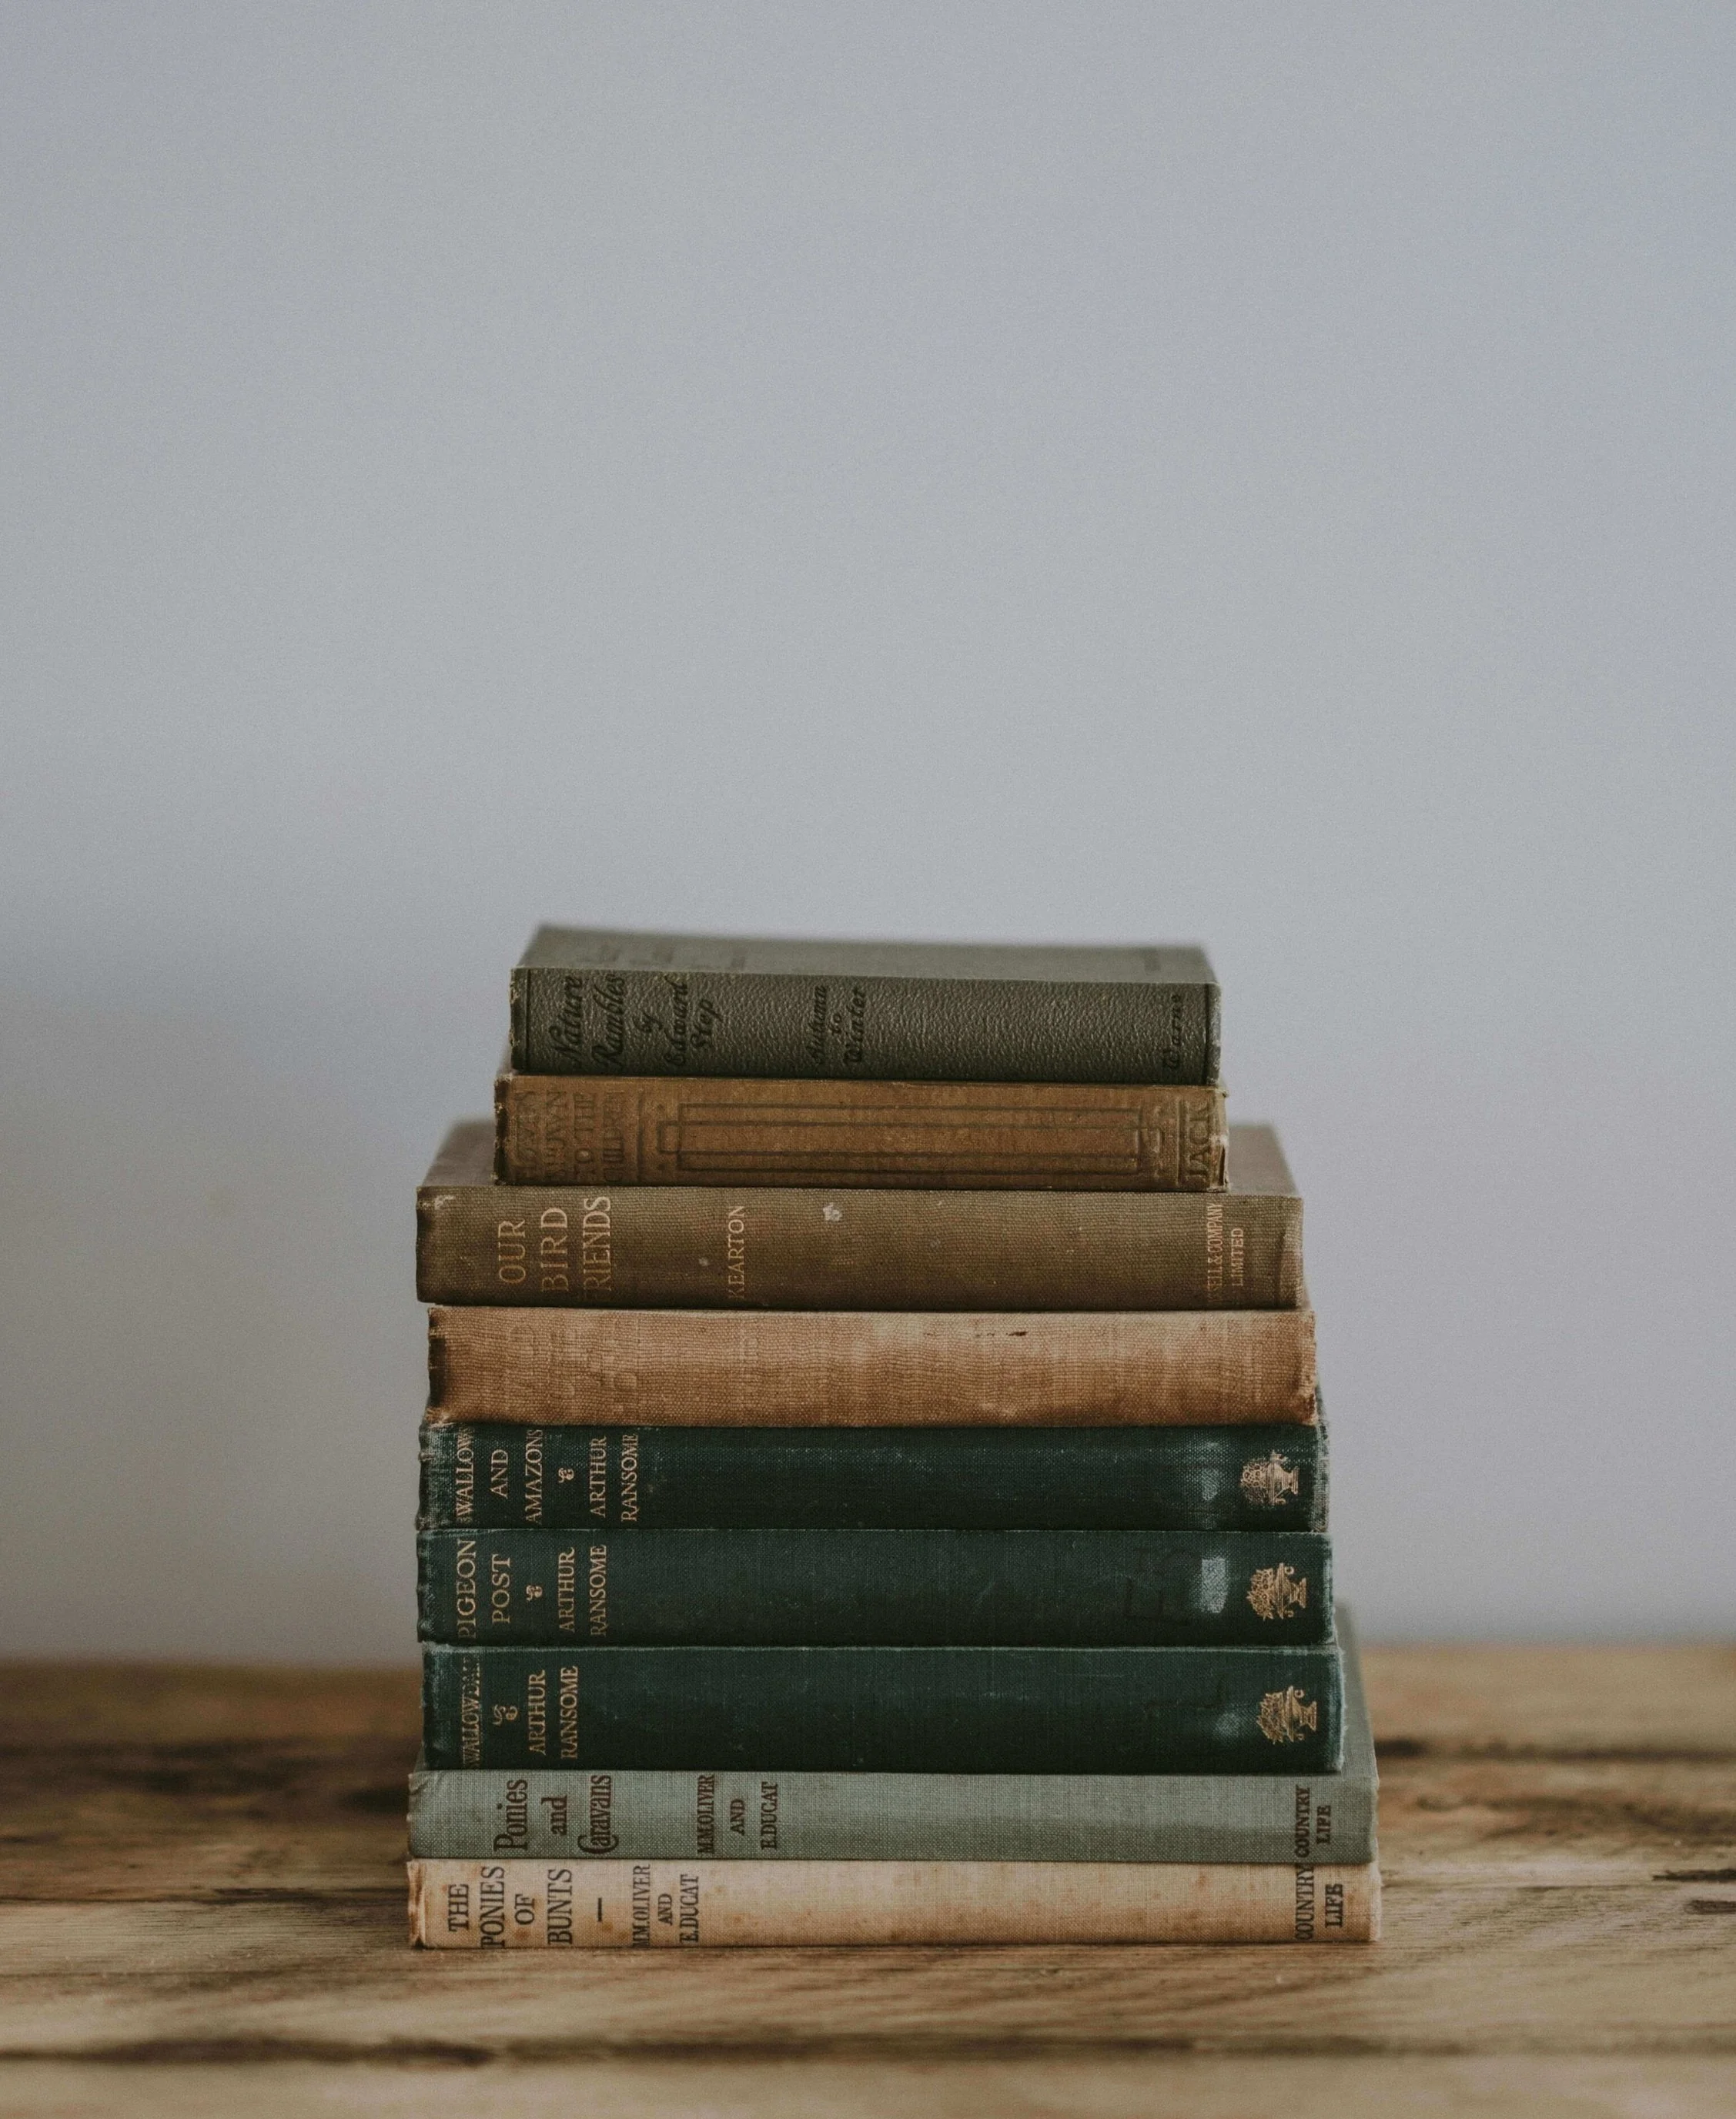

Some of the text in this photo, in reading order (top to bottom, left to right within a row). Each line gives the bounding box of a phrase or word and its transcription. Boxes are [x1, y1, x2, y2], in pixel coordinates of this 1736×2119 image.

[548, 975, 583, 1067] Nature
[591, 974, 627, 1069] Rambles
[634, 1014, 661, 1034] by
[664, 982, 688, 1067] Edward
[690, 998, 722, 1049] Step
[829, 1014, 843, 1035] to
[844, 987, 865, 1065] Winter
[1187, 1106, 1209, 1180] JACK
[499, 1220, 526, 1284] OUR
[540, 1207, 568, 1292] BIRD
[728, 1205, 745, 1299] KEARTON
[1206, 1202, 1223, 1253] COMPANY
[1207, 1253, 1223, 1265] &
[1231, 1228, 1244, 1287] LIMITED
[490, 1449, 508, 1499] AND
[525, 1429, 542, 1524] AMAZONS
[590, 1436, 607, 1518] ARTHUR
[621, 1434, 639, 1521] RANSOME
[457, 1539, 476, 1639] PIGEON
[491, 1553, 510, 1623] POST
[558, 1547, 575, 1633] ARTHUR
[590, 1545, 607, 1636] RANSOME
[529, 1669, 546, 1755] ARTHUR
[560, 1666, 578, 1759] RANSOME
[493, 1780, 528, 1851] Ponies
[541, 1796, 567, 1836] and
[577, 1775, 619, 1853] Caravans
[730, 1799, 745, 1835] AND
[1295, 1785, 1310, 1858] COUNTRY
[1316, 1805, 1330, 1844] LIFE
[448, 1884, 469, 1932] THE
[480, 1866, 506, 1947] PONIES
[514, 1893, 535, 1925] OF
[547, 1869, 573, 1944] BUNTS
[657, 1893, 672, 1925] AND
[679, 1874, 699, 1943] E.DUCAT
[1295, 1864, 1314, 1940] COUNTRY
[1325, 1883, 1343, 1927] LIFE
